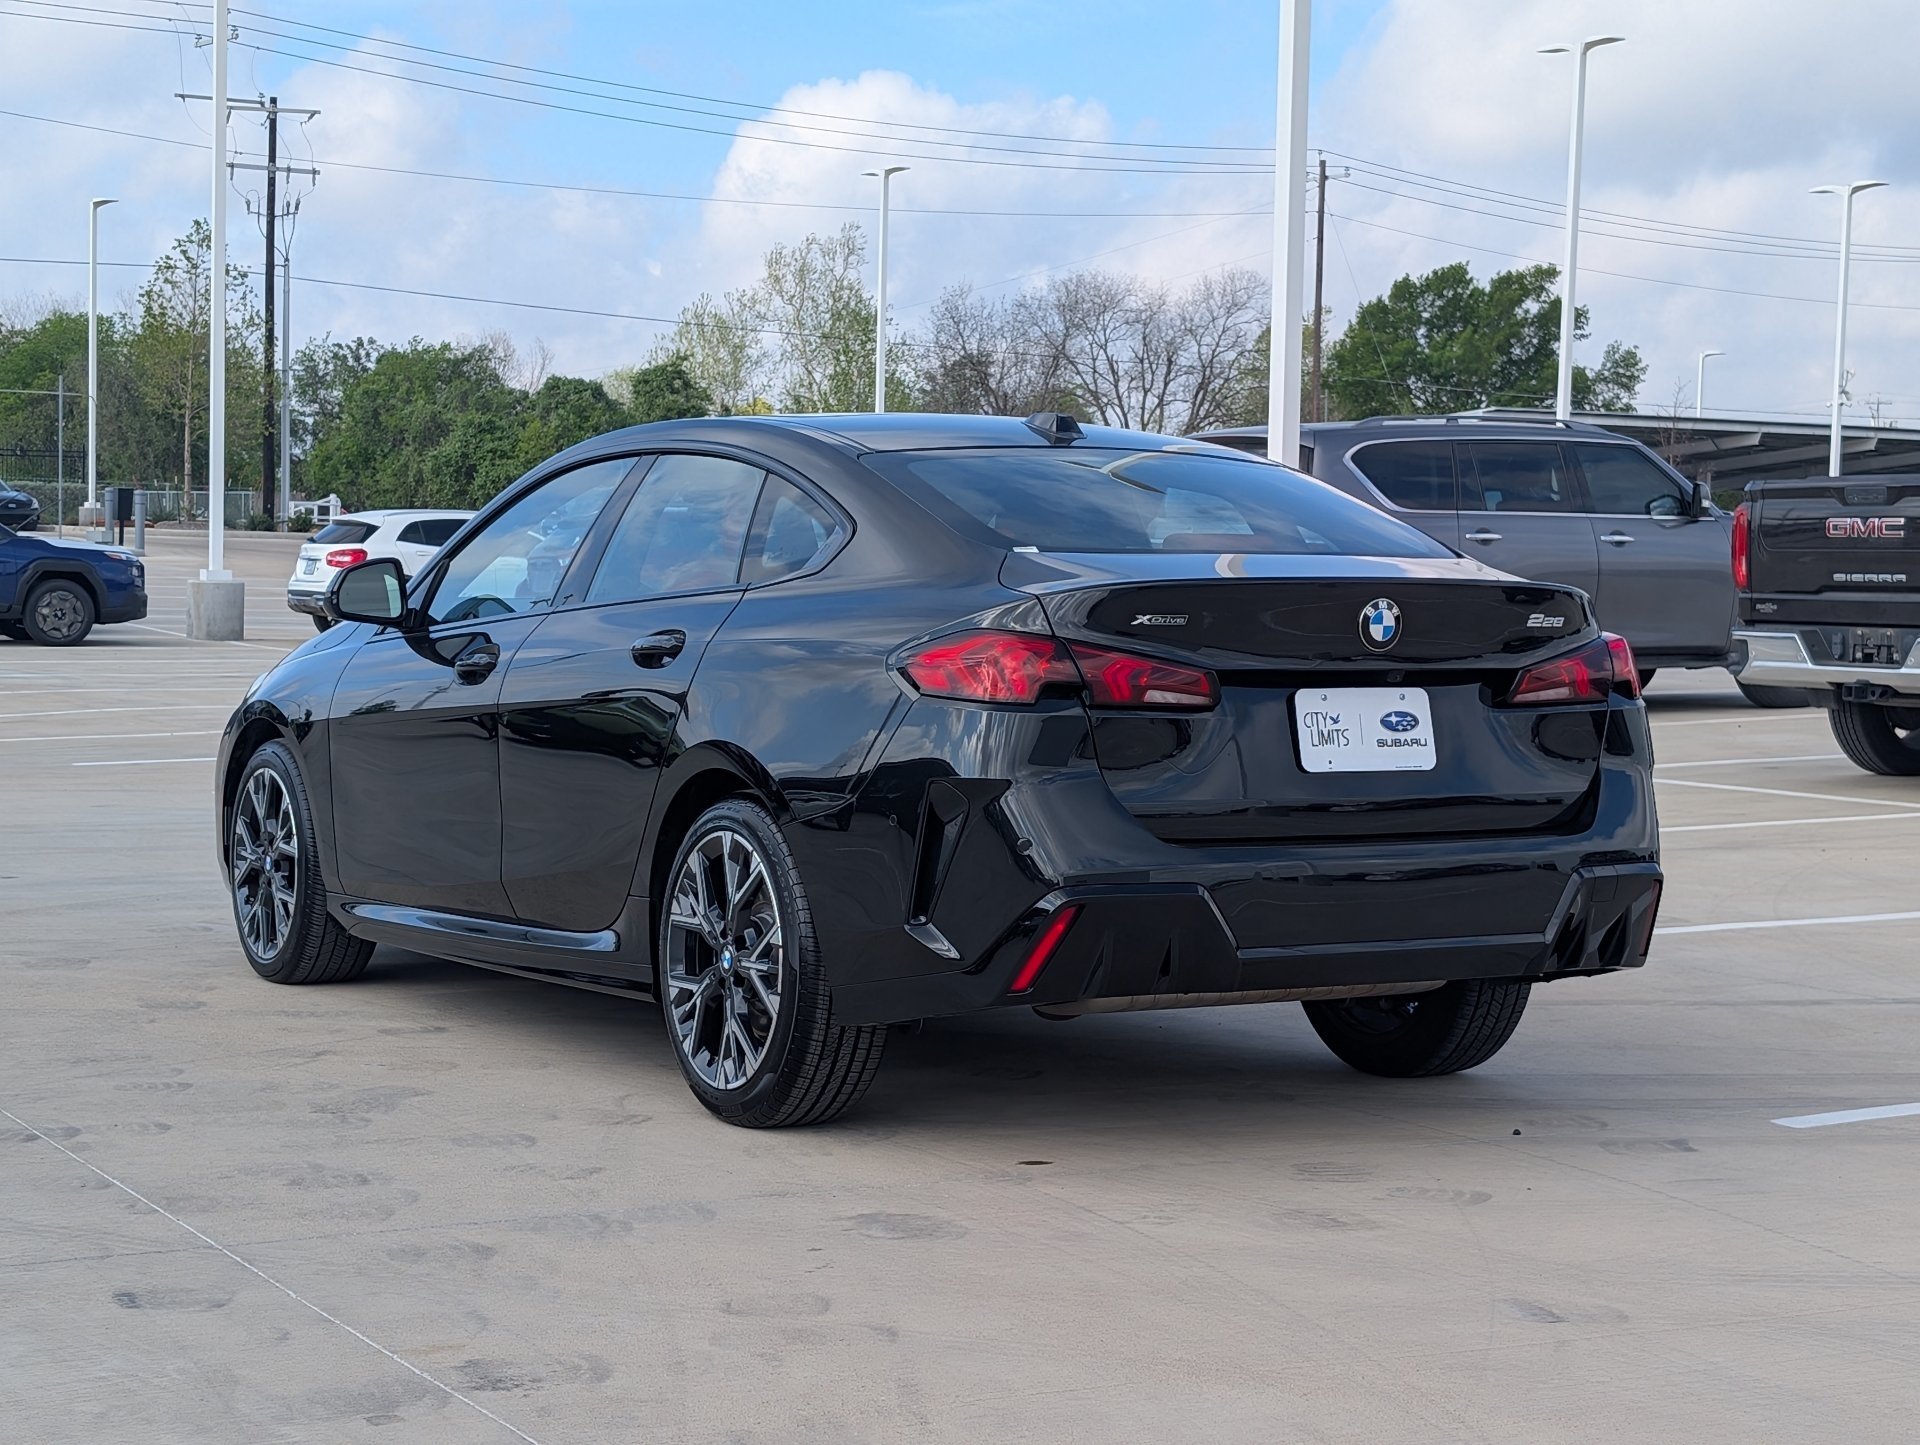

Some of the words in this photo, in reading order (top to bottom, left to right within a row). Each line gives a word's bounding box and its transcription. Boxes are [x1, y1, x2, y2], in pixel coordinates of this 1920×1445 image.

[1826, 518, 1905, 538] GMC
[1833, 573, 1907, 582] SIERRA
[1365, 600, 1401, 617] BMW
[1526, 613, 1565, 627] 228
[1303, 711, 1328, 729] CITY
[1310, 728, 1349, 748] LIMITS
[1376, 738, 1428, 748] SUBARU
